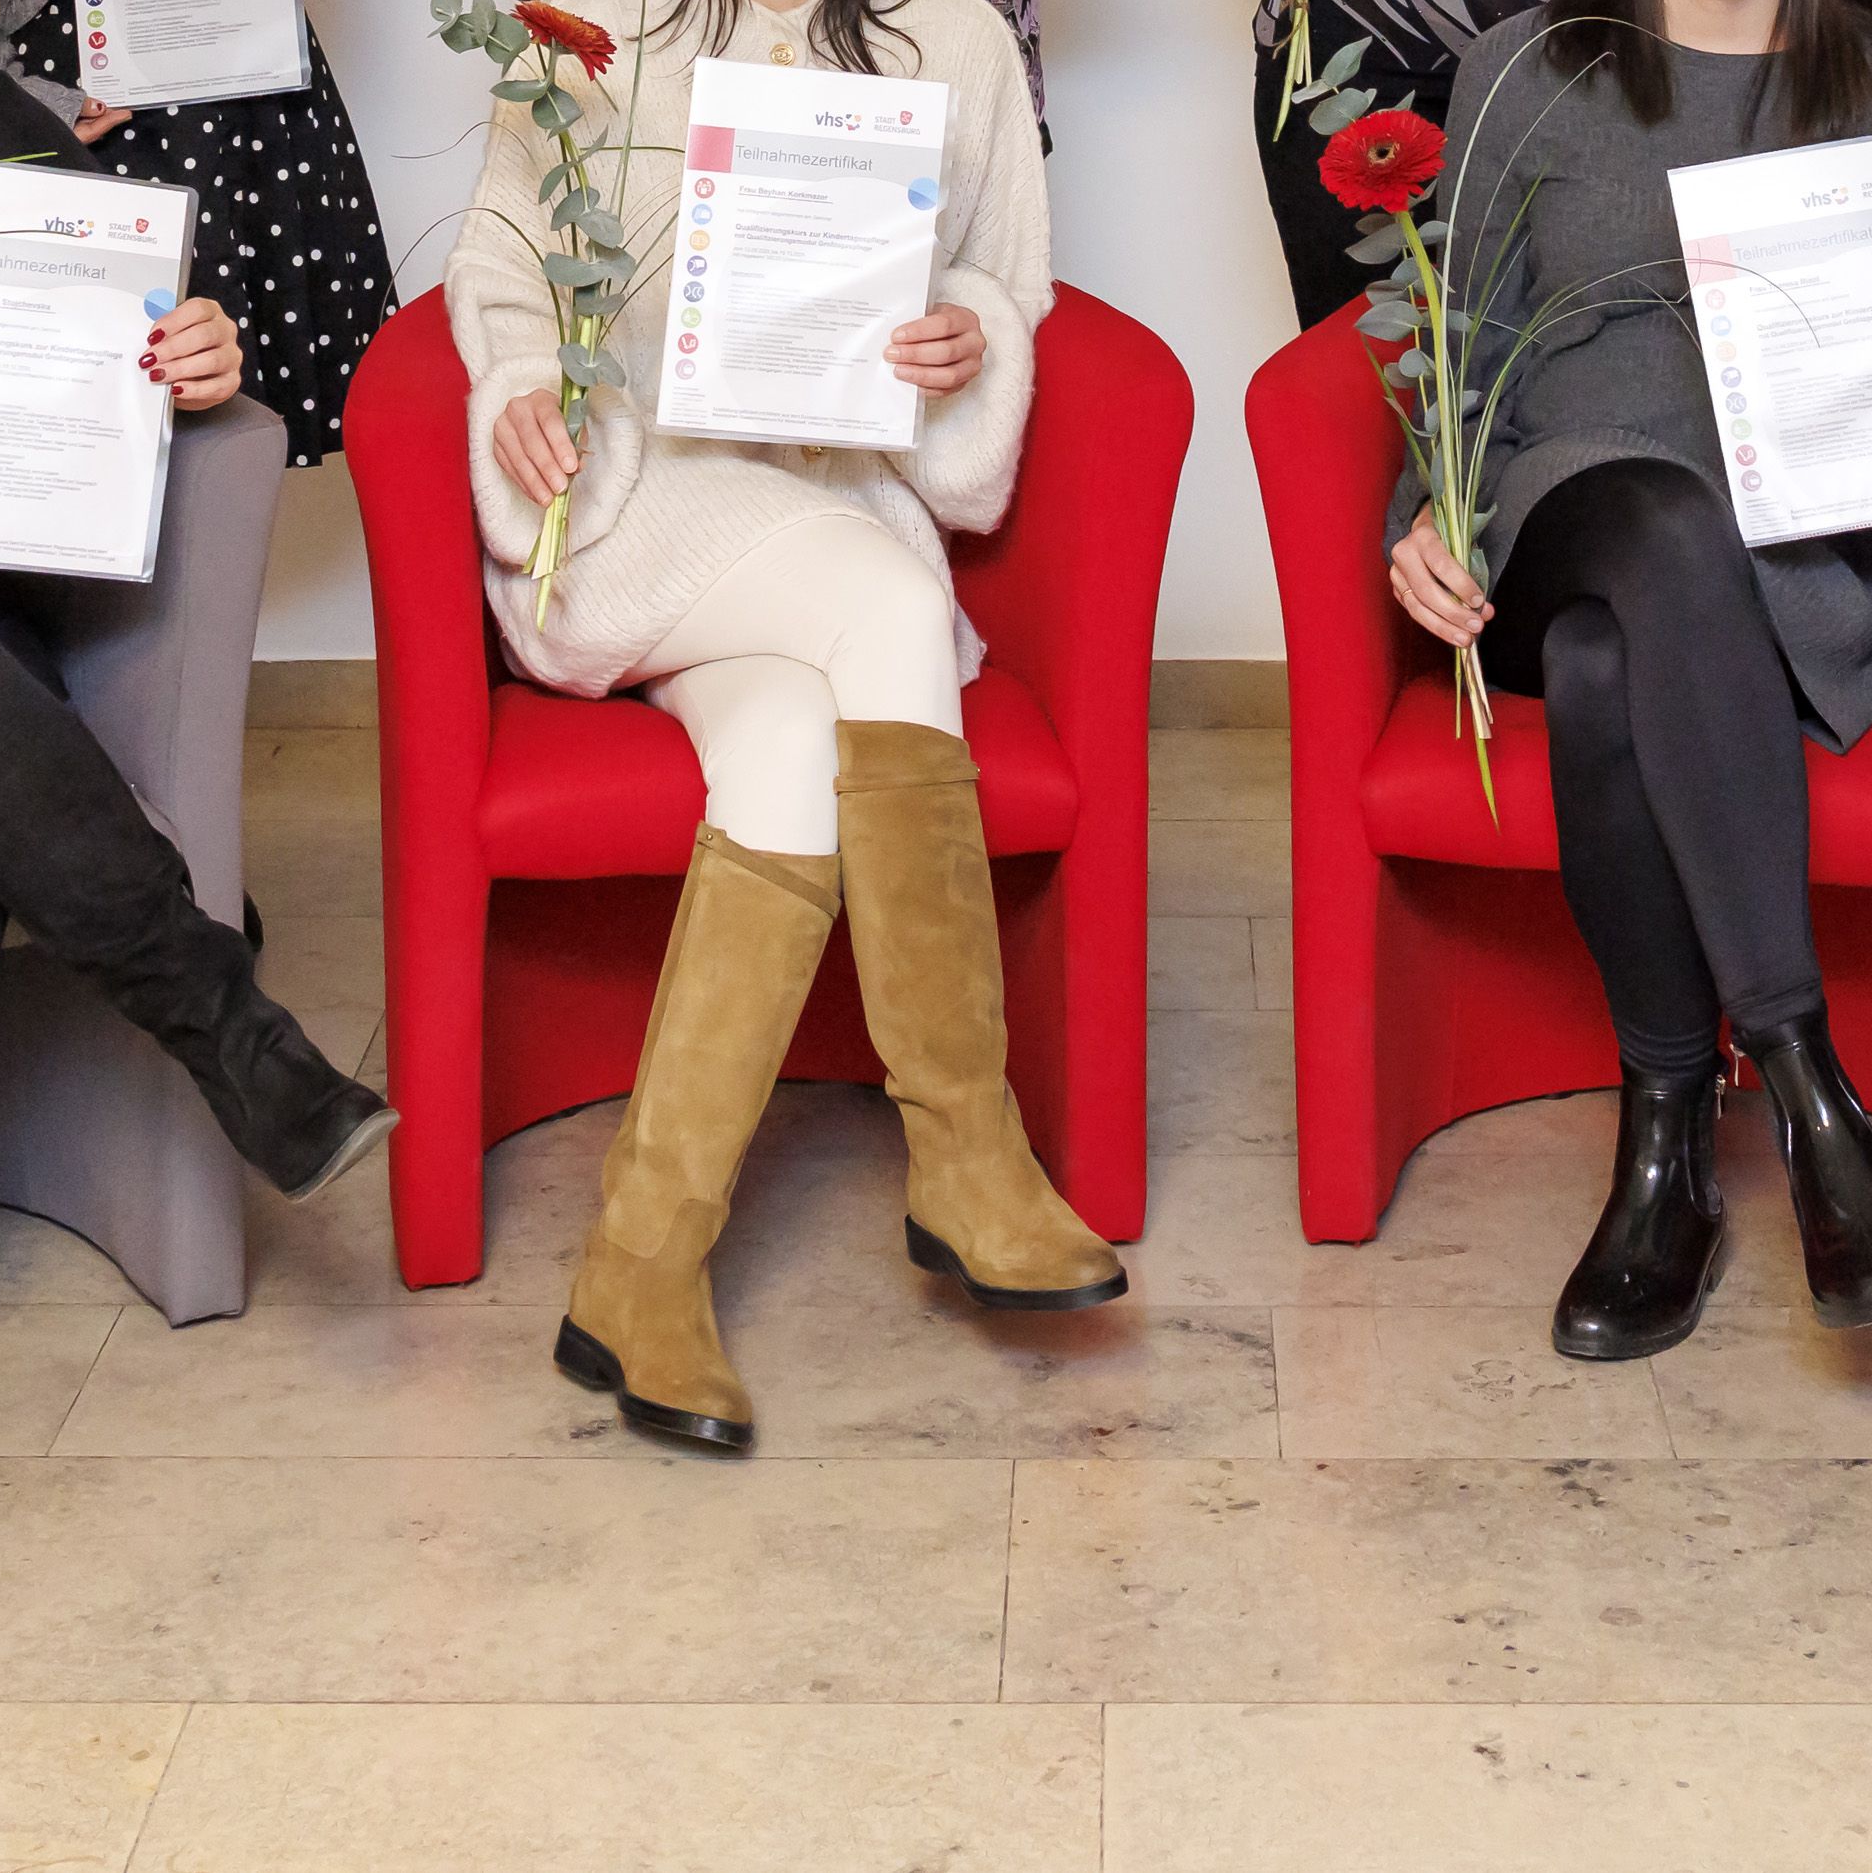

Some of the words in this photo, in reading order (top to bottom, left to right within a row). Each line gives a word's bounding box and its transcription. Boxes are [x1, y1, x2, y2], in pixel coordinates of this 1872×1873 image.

[815, 111, 843, 128] vhs
[874, 115, 896, 125] STADT
[735, 144, 873, 172] Teilnahmezertifikat
[1801, 189, 1832, 209] vhs
[44, 216, 75, 234] vhs
[108, 222, 132, 232] STADT
[107, 231, 158, 245] REGENSBURG
